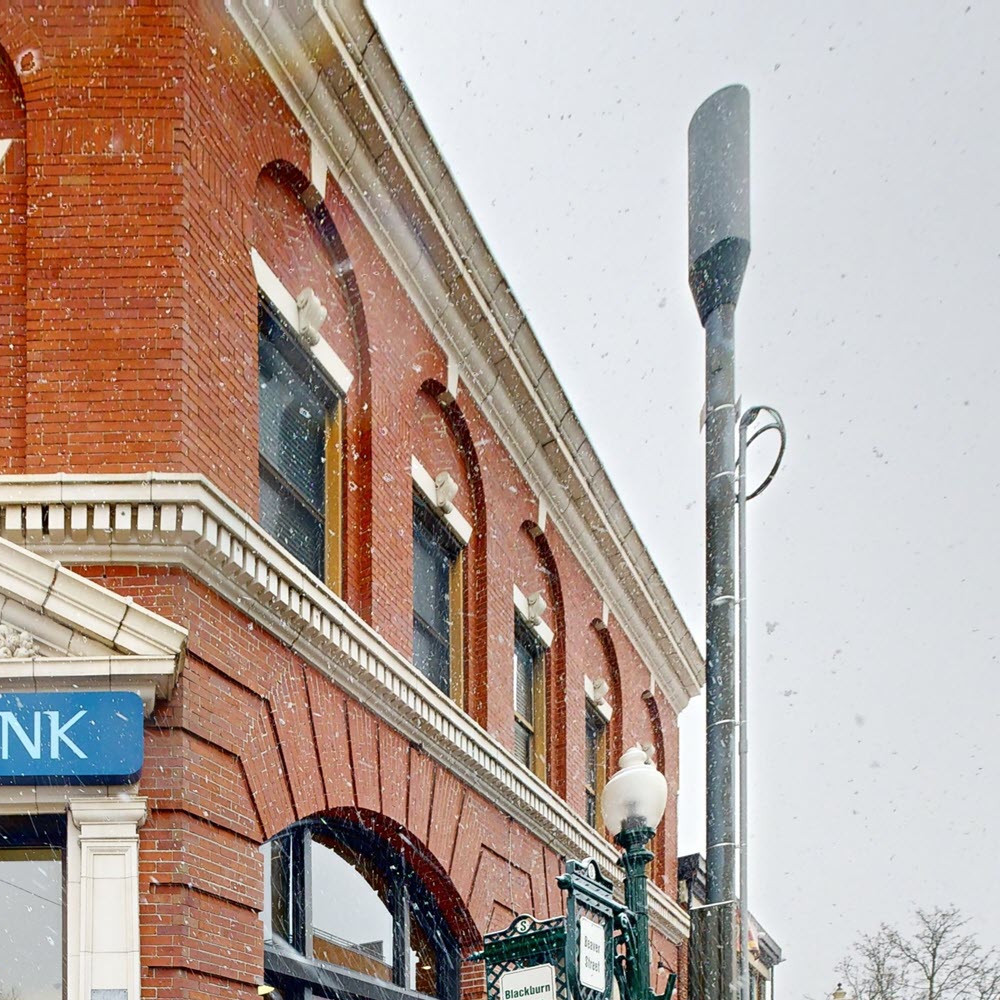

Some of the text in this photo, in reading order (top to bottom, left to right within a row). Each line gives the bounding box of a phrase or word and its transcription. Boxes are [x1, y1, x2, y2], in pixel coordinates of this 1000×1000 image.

[584, 936, 601, 954] Beaver
[584, 955, 601, 973] Street
[505, 983, 551, 1000] Blackburn
